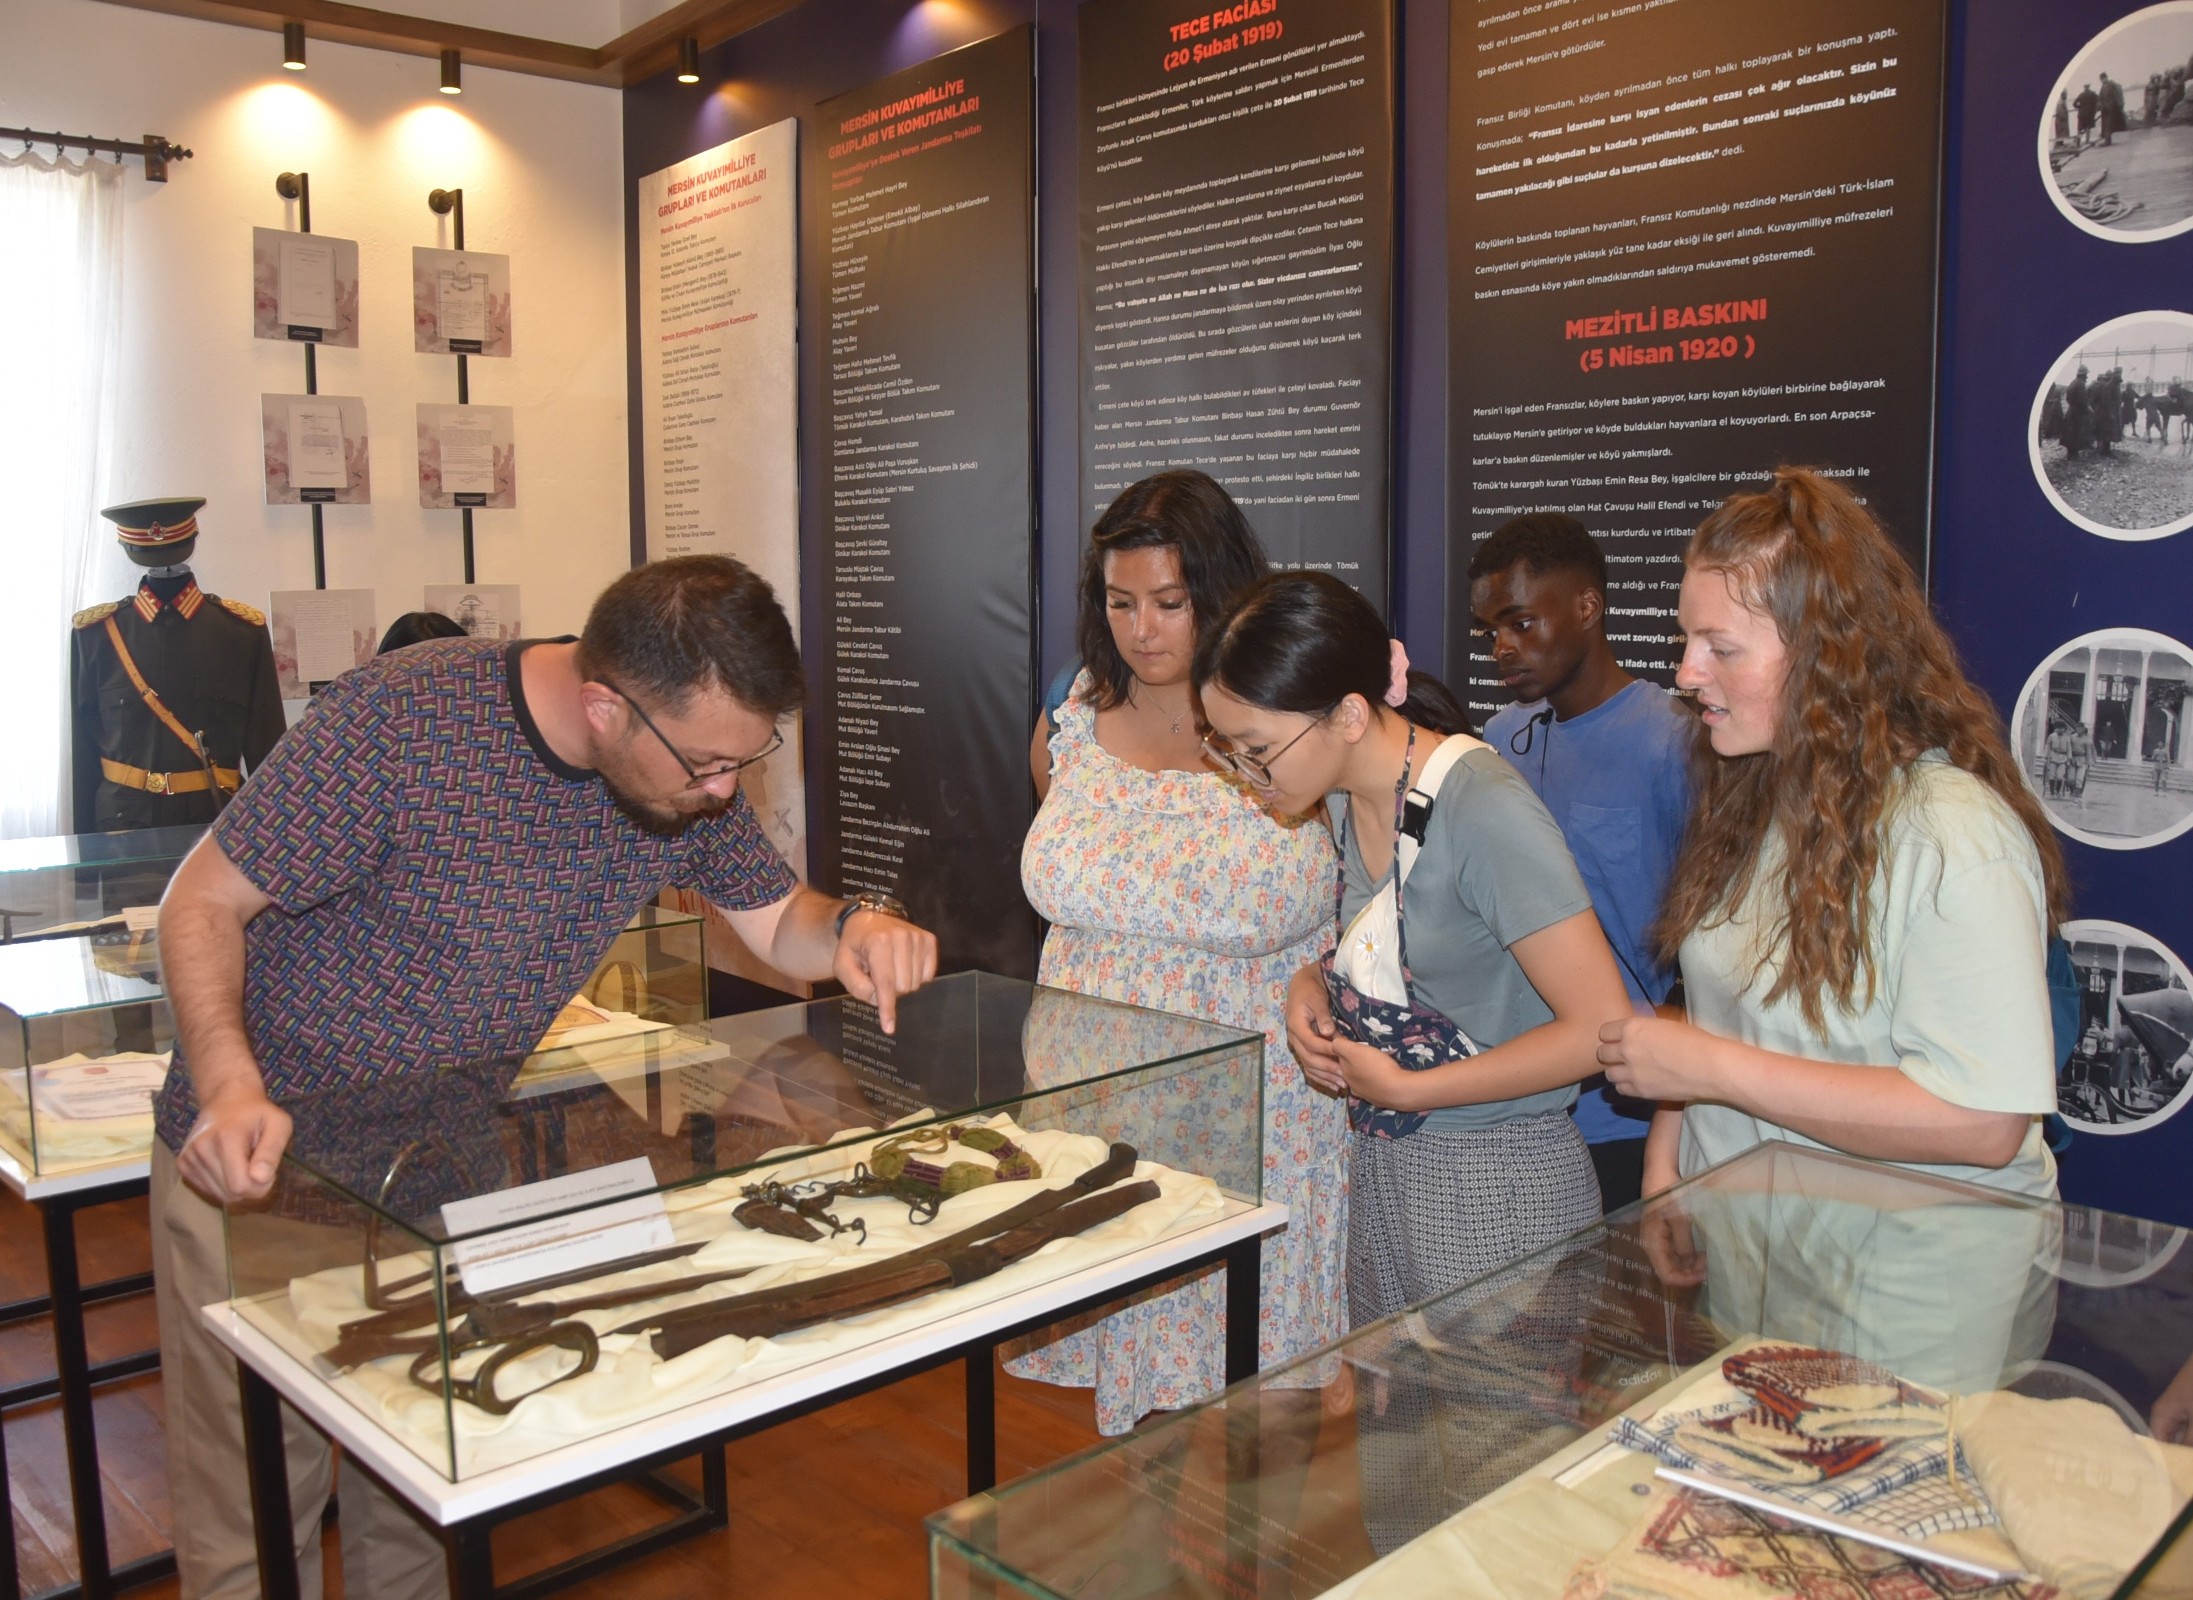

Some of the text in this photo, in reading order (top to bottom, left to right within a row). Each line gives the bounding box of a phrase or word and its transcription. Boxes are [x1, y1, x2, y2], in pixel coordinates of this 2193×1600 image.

[1170, 0, 1277, 41] TECE FACİASI
[1163, 20, 1283, 70] (20 Şubat 1919)
[1476, 114, 1504, 126] Fransız
[1507, 106, 1530, 120] Birliği
[1534, 99, 1575, 113] Komutanı,
[1579, 91, 1610, 104] köyden
[1613, 79, 1661, 97] ayrılmadan
[1665, 74, 1688, 85] önce
[1692, 68, 1710, 79] tüm
[1741, 49, 1793, 68] toplayarak
[1797, 45, 1812, 56] bir
[1816, 35, 1863, 52] konuşma
[1867, 27, 1898, 43] yaptı.
[829, 96, 979, 159] GRUPLARI VE KOMUTANLARI
[840, 80, 964, 135] MERSİN KUVAYIMİLLİYE
[1475, 87, 1896, 176] hareketiniz ilk olduğundan bu kadarla yetinilmiştir. Bundan sonraki suçlarınızda köyünüz
[658, 168, 766, 218] GRUPLARI VE KOMUTANLARI
[668, 153, 755, 197] MERSİN KUVAYIMİLLİYE
[1475, 178, 1894, 250] Köylülerin baskında toplanan hayvanları, Fransız Komutanlığı nezdinde Mersin'deki Türk-İslam
[1565, 298, 1768, 339] MEZİTLİ BASKINI
[1580, 334, 1756, 372] (5 Nisan 1920 )
[1473, 377, 1885, 416] Mersin'i işgal eden Fransızlar, köylere baskın yapıyor, karşı koyan köylüleri birbirine bağlayarak
[1472, 409, 1875, 441] tutuklayıp Mersin'e getiriyor ve köyde buldukları hayvanlara el koyuyorlardı. En son Arpaçsa-
[1472, 456, 1501, 465] karlar'a
[1502, 455, 1528, 464] baskın
[1529, 452, 1585, 462] düzenlemişler
[1599, 449, 1620, 460] köyü
[1621, 447, 1673, 459] yakmışlardı.
[1472, 470, 1772, 490] Tömük'te karargah kuran Yüzbaşı Emin Resa Bey, işgalcilere bir gözdağı
[1610, 527, 1649, 537] kurdurdu
[1645, 554, 1682, 564] yazdırdı.
[1621, 580, 1645, 590] aldığı
[1609, 606, 1670, 617] Kuvayımilliye
[1624, 658, 1667, 669] ifade etti.
